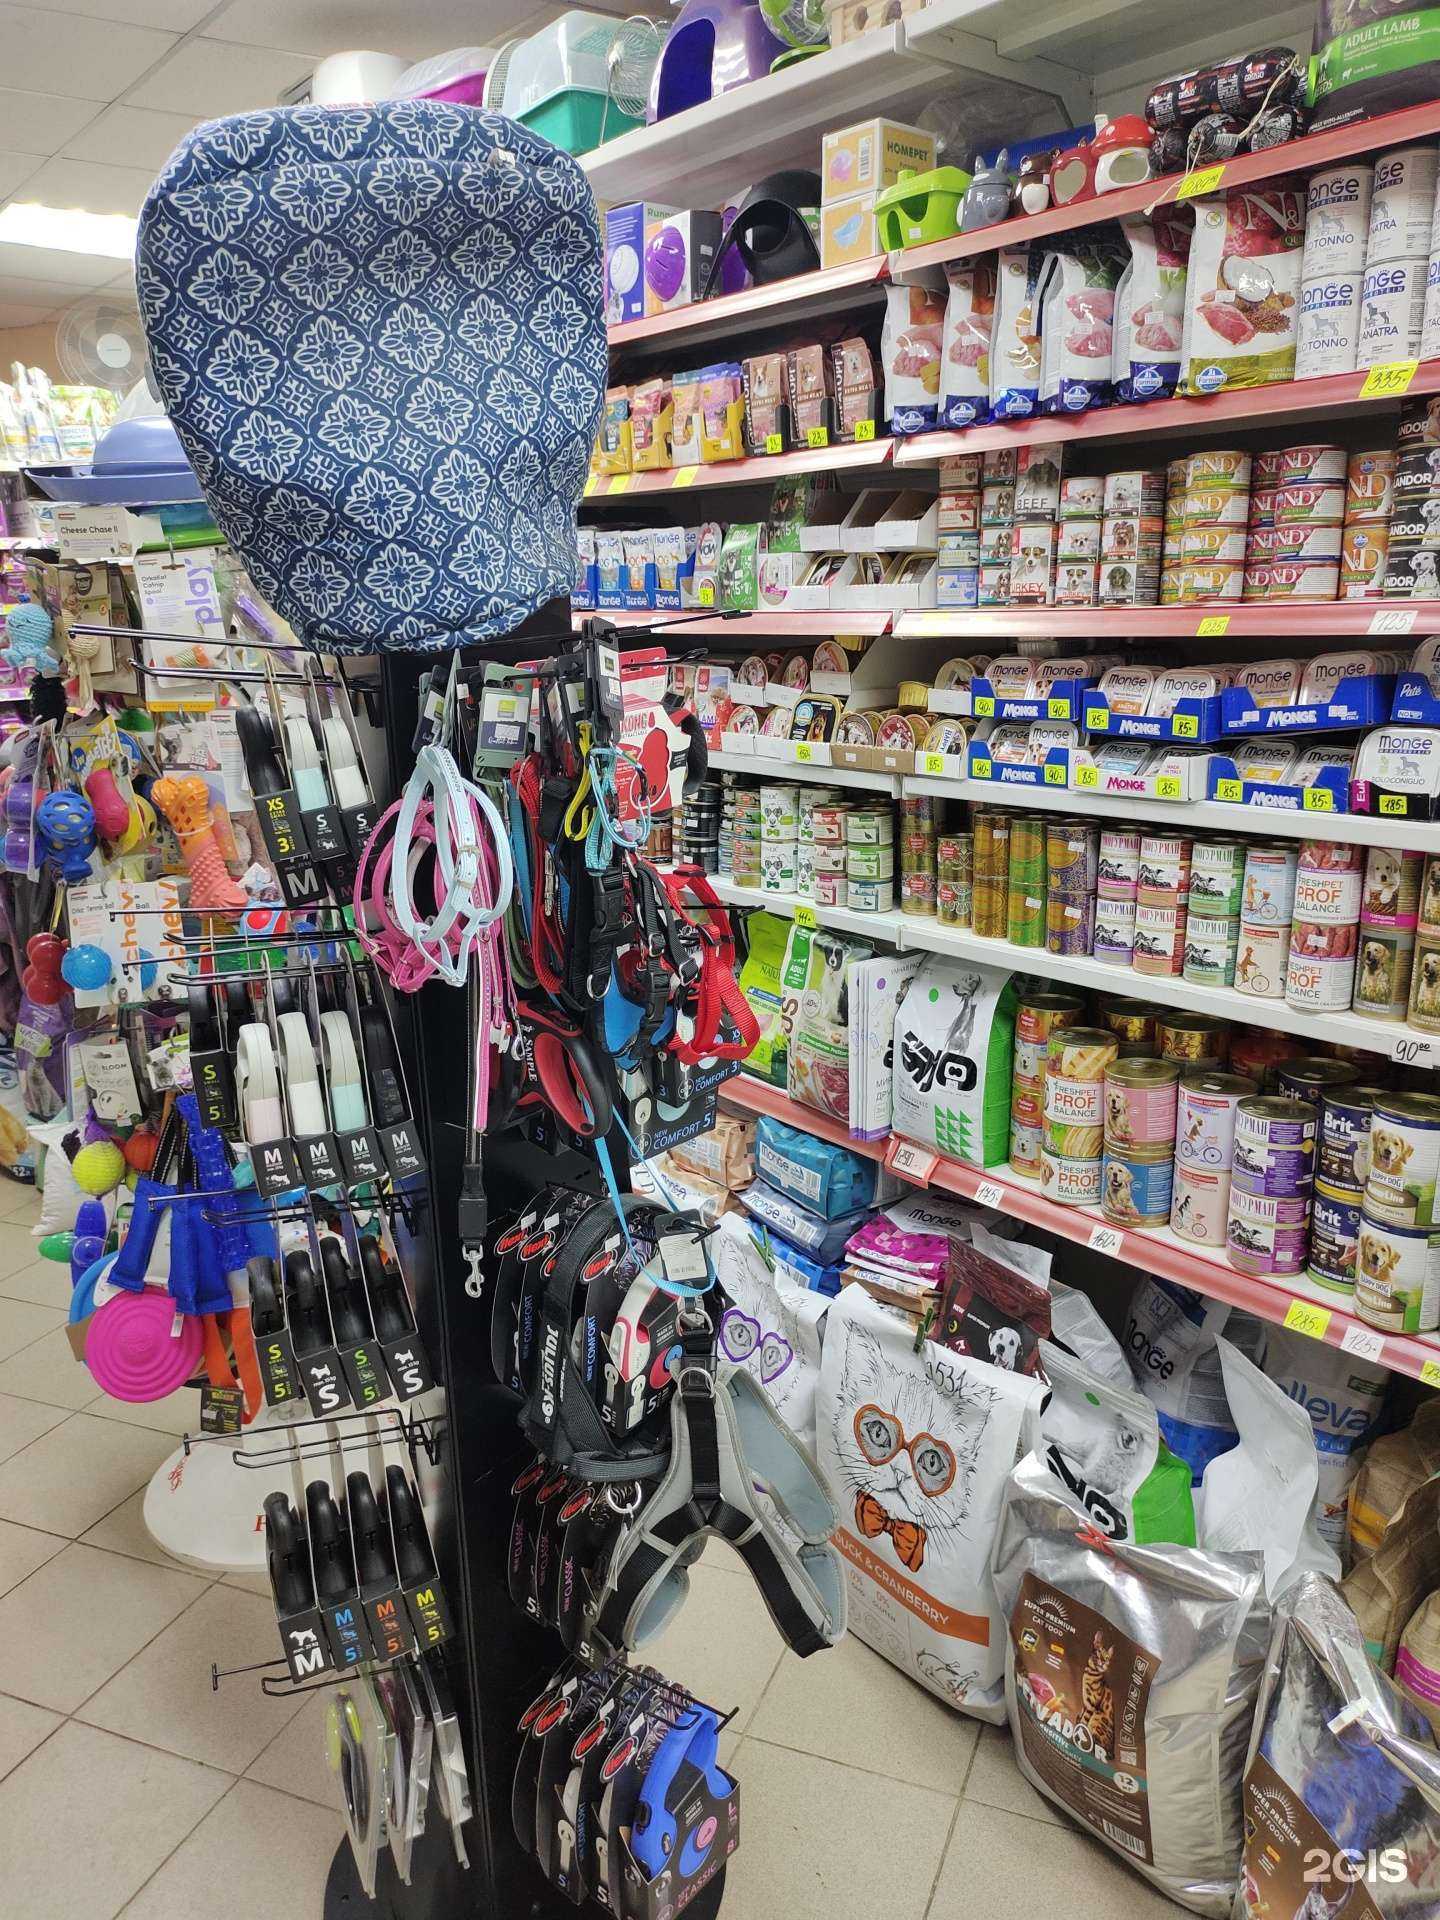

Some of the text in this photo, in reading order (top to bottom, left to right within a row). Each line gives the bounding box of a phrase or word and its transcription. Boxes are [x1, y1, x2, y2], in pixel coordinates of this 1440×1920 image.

[1345, 17, 1420, 49] ADULT LAMB
[886, 141, 928, 162] HOMEPET
[1016, 497, 1048, 510] BEEF
[61, 525, 87, 534] Cheese
[89, 525, 112, 534] Chase
[1002, 702, 1039, 718] MONGE
[1119, 719, 1161, 736] MONGE
[1266, 710, 1317, 728] MONGE
[1001, 767, 1037, 783] MONGE
[1107, 776, 1146, 792] MONGE
[266, 797, 285, 812] XS
[1249, 790, 1299, 810] MONGE
[316, 813, 328, 828] S
[356, 813, 368, 827] S
[277, 837, 290, 853] 3
[287, 867, 320, 898] M
[1298, 876, 1344, 889] FRESHPET
[1297, 887, 1342, 902] PROF
[524, 1039, 538, 1082] SAMPLE
[203, 1064, 217, 1081] S
[695, 1068, 729, 1092] COMFORT
[1054, 1085, 1097, 1096] FRESHPET
[1054, 1094, 1097, 1109] PROF
[209, 1105, 220, 1121] 5
[1053, 1106, 1097, 1118] BALANCE
[1324, 1110, 1354, 1134] Brit
[391, 1130, 409, 1148] M
[653, 1112, 711, 1150] COMFORT 5
[309, 1142, 328, 1158] M
[350, 1137, 369, 1153] M
[264, 1147, 283, 1164] M
[1314, 1200, 1342, 1227] Brit
[587, 1315, 597, 1365] COMFORT
[269, 1343, 282, 1360] S
[354, 1350, 368, 1366] S
[402, 1368, 424, 1394] S
[274, 1382, 287, 1398] 5
[318, 1383, 340, 1409] S
[363, 1386, 376, 1401] 5
[834, 1530, 863, 1561] DUCK
[875, 1565, 950, 1626] CRANBERRY
[416, 1588, 435, 1607] M
[376, 1599, 395, 1618] M
[335, 1608, 353, 1627] M
[1024, 1600, 1076, 1635] SUPER PREMIUM
[427, 1626, 439, 1641] 5
[1032, 1617, 1063, 1637] CAT FOOD
[387, 1637, 399, 1653] 5
[293, 1647, 325, 1676] M
[345, 1648, 356, 1662] 5
[1248, 1783, 1302, 1847] SUPER PREMIUM
[1253, 1804, 1286, 1843] CAT FOOD
